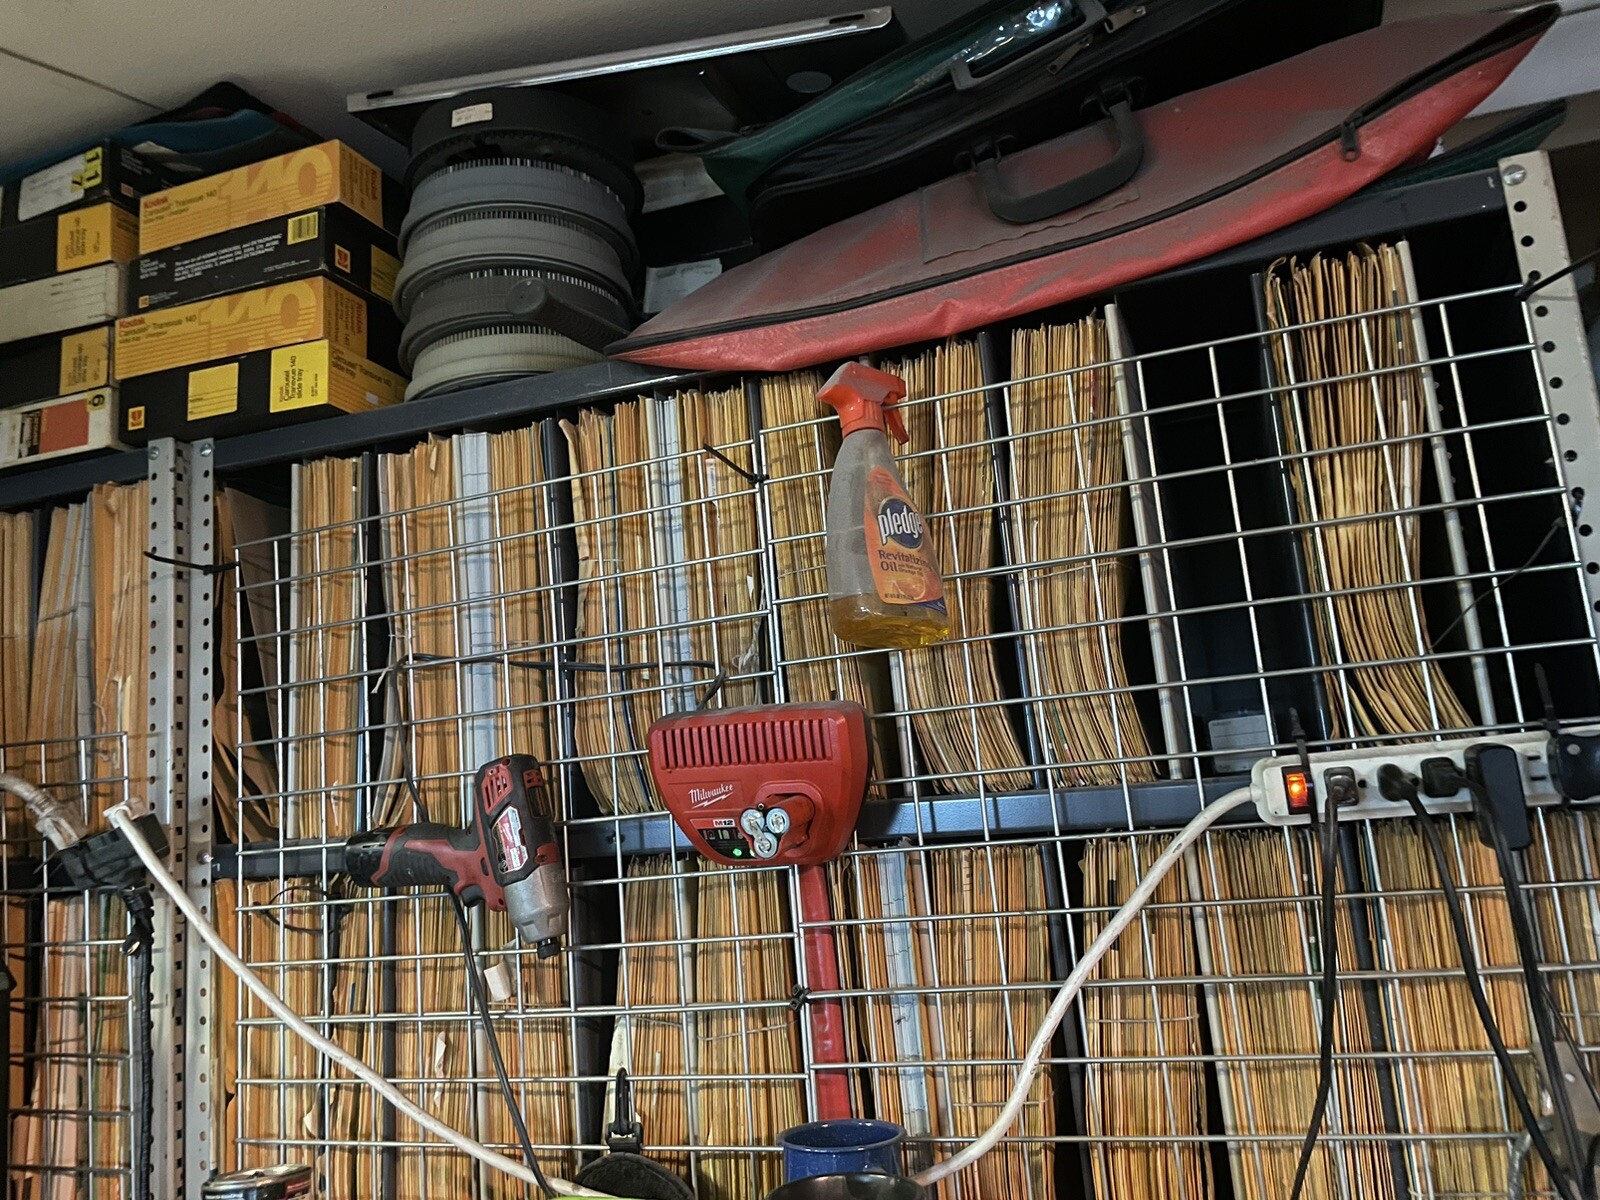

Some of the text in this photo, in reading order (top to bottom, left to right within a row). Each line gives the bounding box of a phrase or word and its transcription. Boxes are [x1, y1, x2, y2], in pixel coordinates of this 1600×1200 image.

[118, 316, 146, 330] Kodak
[185, 314, 196, 323] 140
[296, 368, 304, 382] tray
[877, 505, 923, 545] pledge
[880, 561, 898, 572] Oil
[688, 783, 734, 804] Milwaukee
